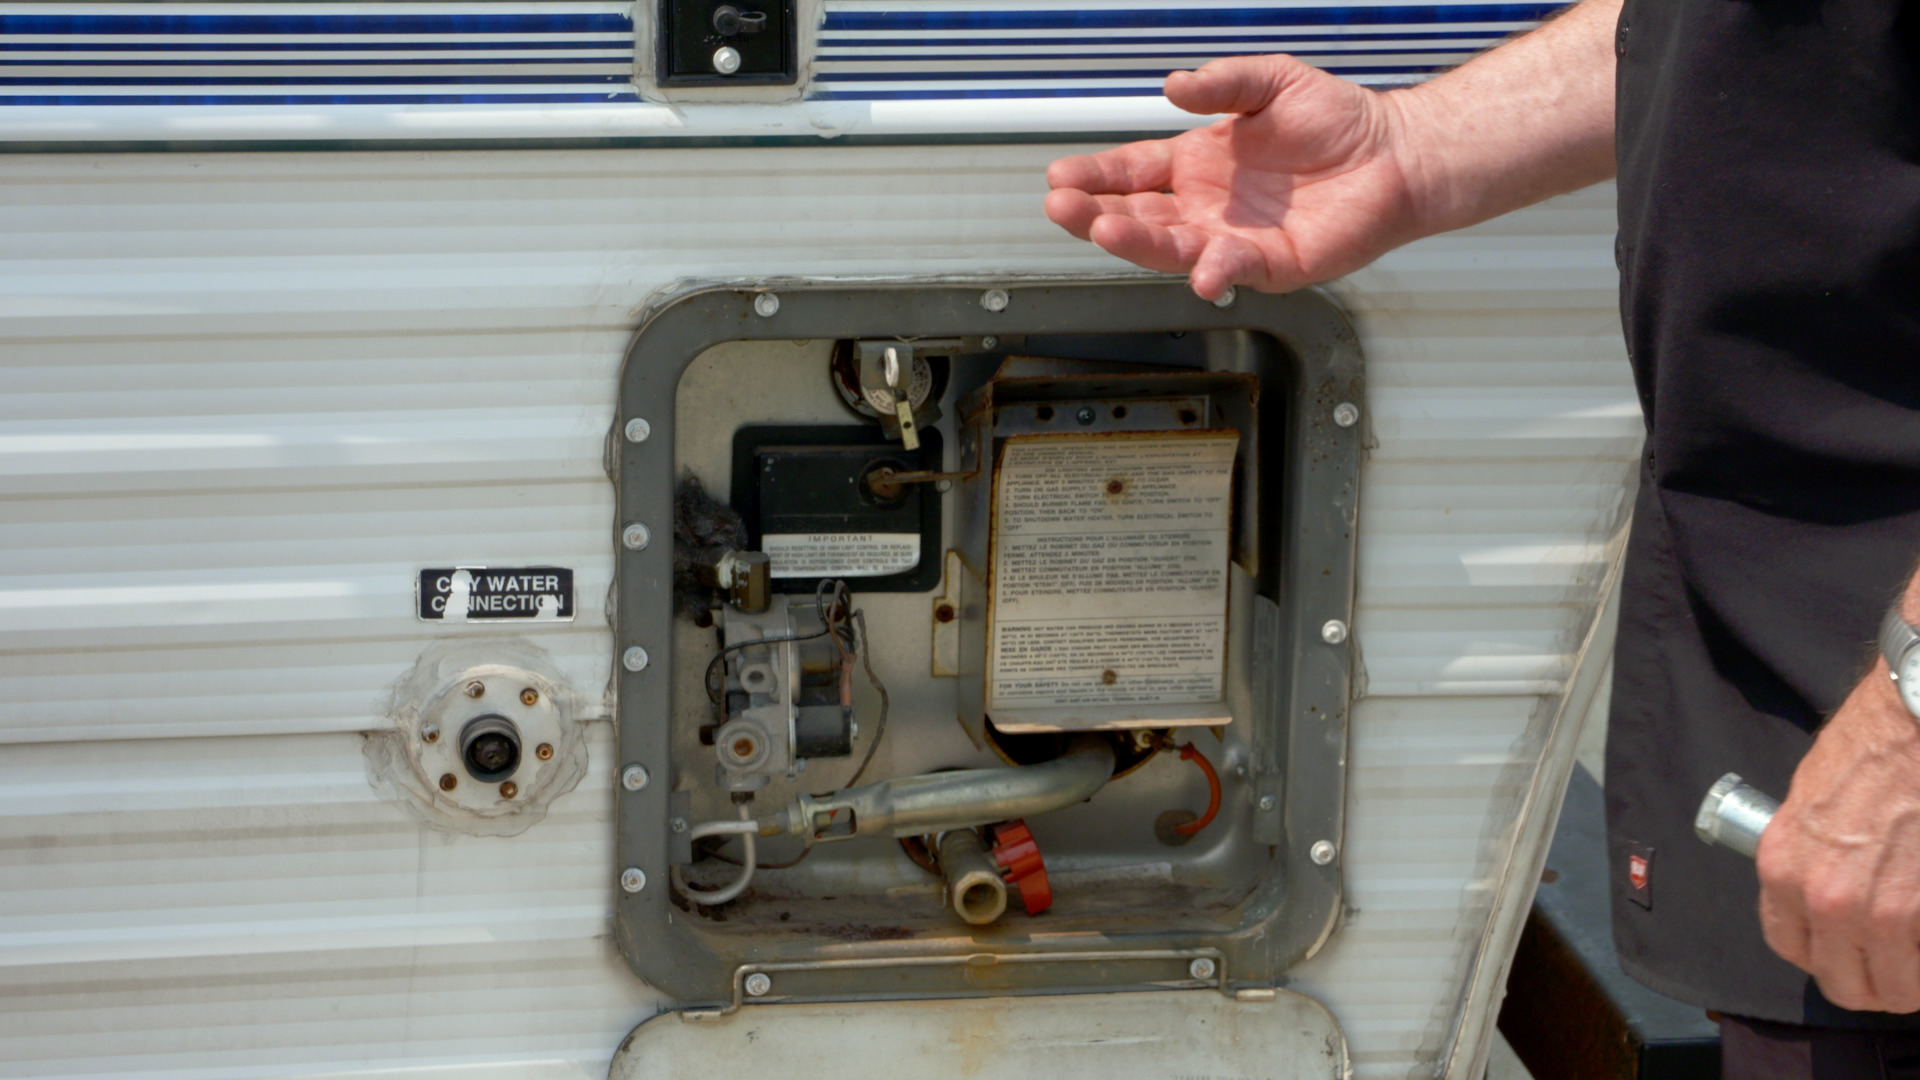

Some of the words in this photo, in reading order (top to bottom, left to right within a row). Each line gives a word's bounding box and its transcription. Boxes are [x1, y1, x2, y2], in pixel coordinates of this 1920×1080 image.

[436, 576, 482, 592] CY
[486, 575, 559, 592] WATER
[431, 594, 564, 612] CNNECTION
